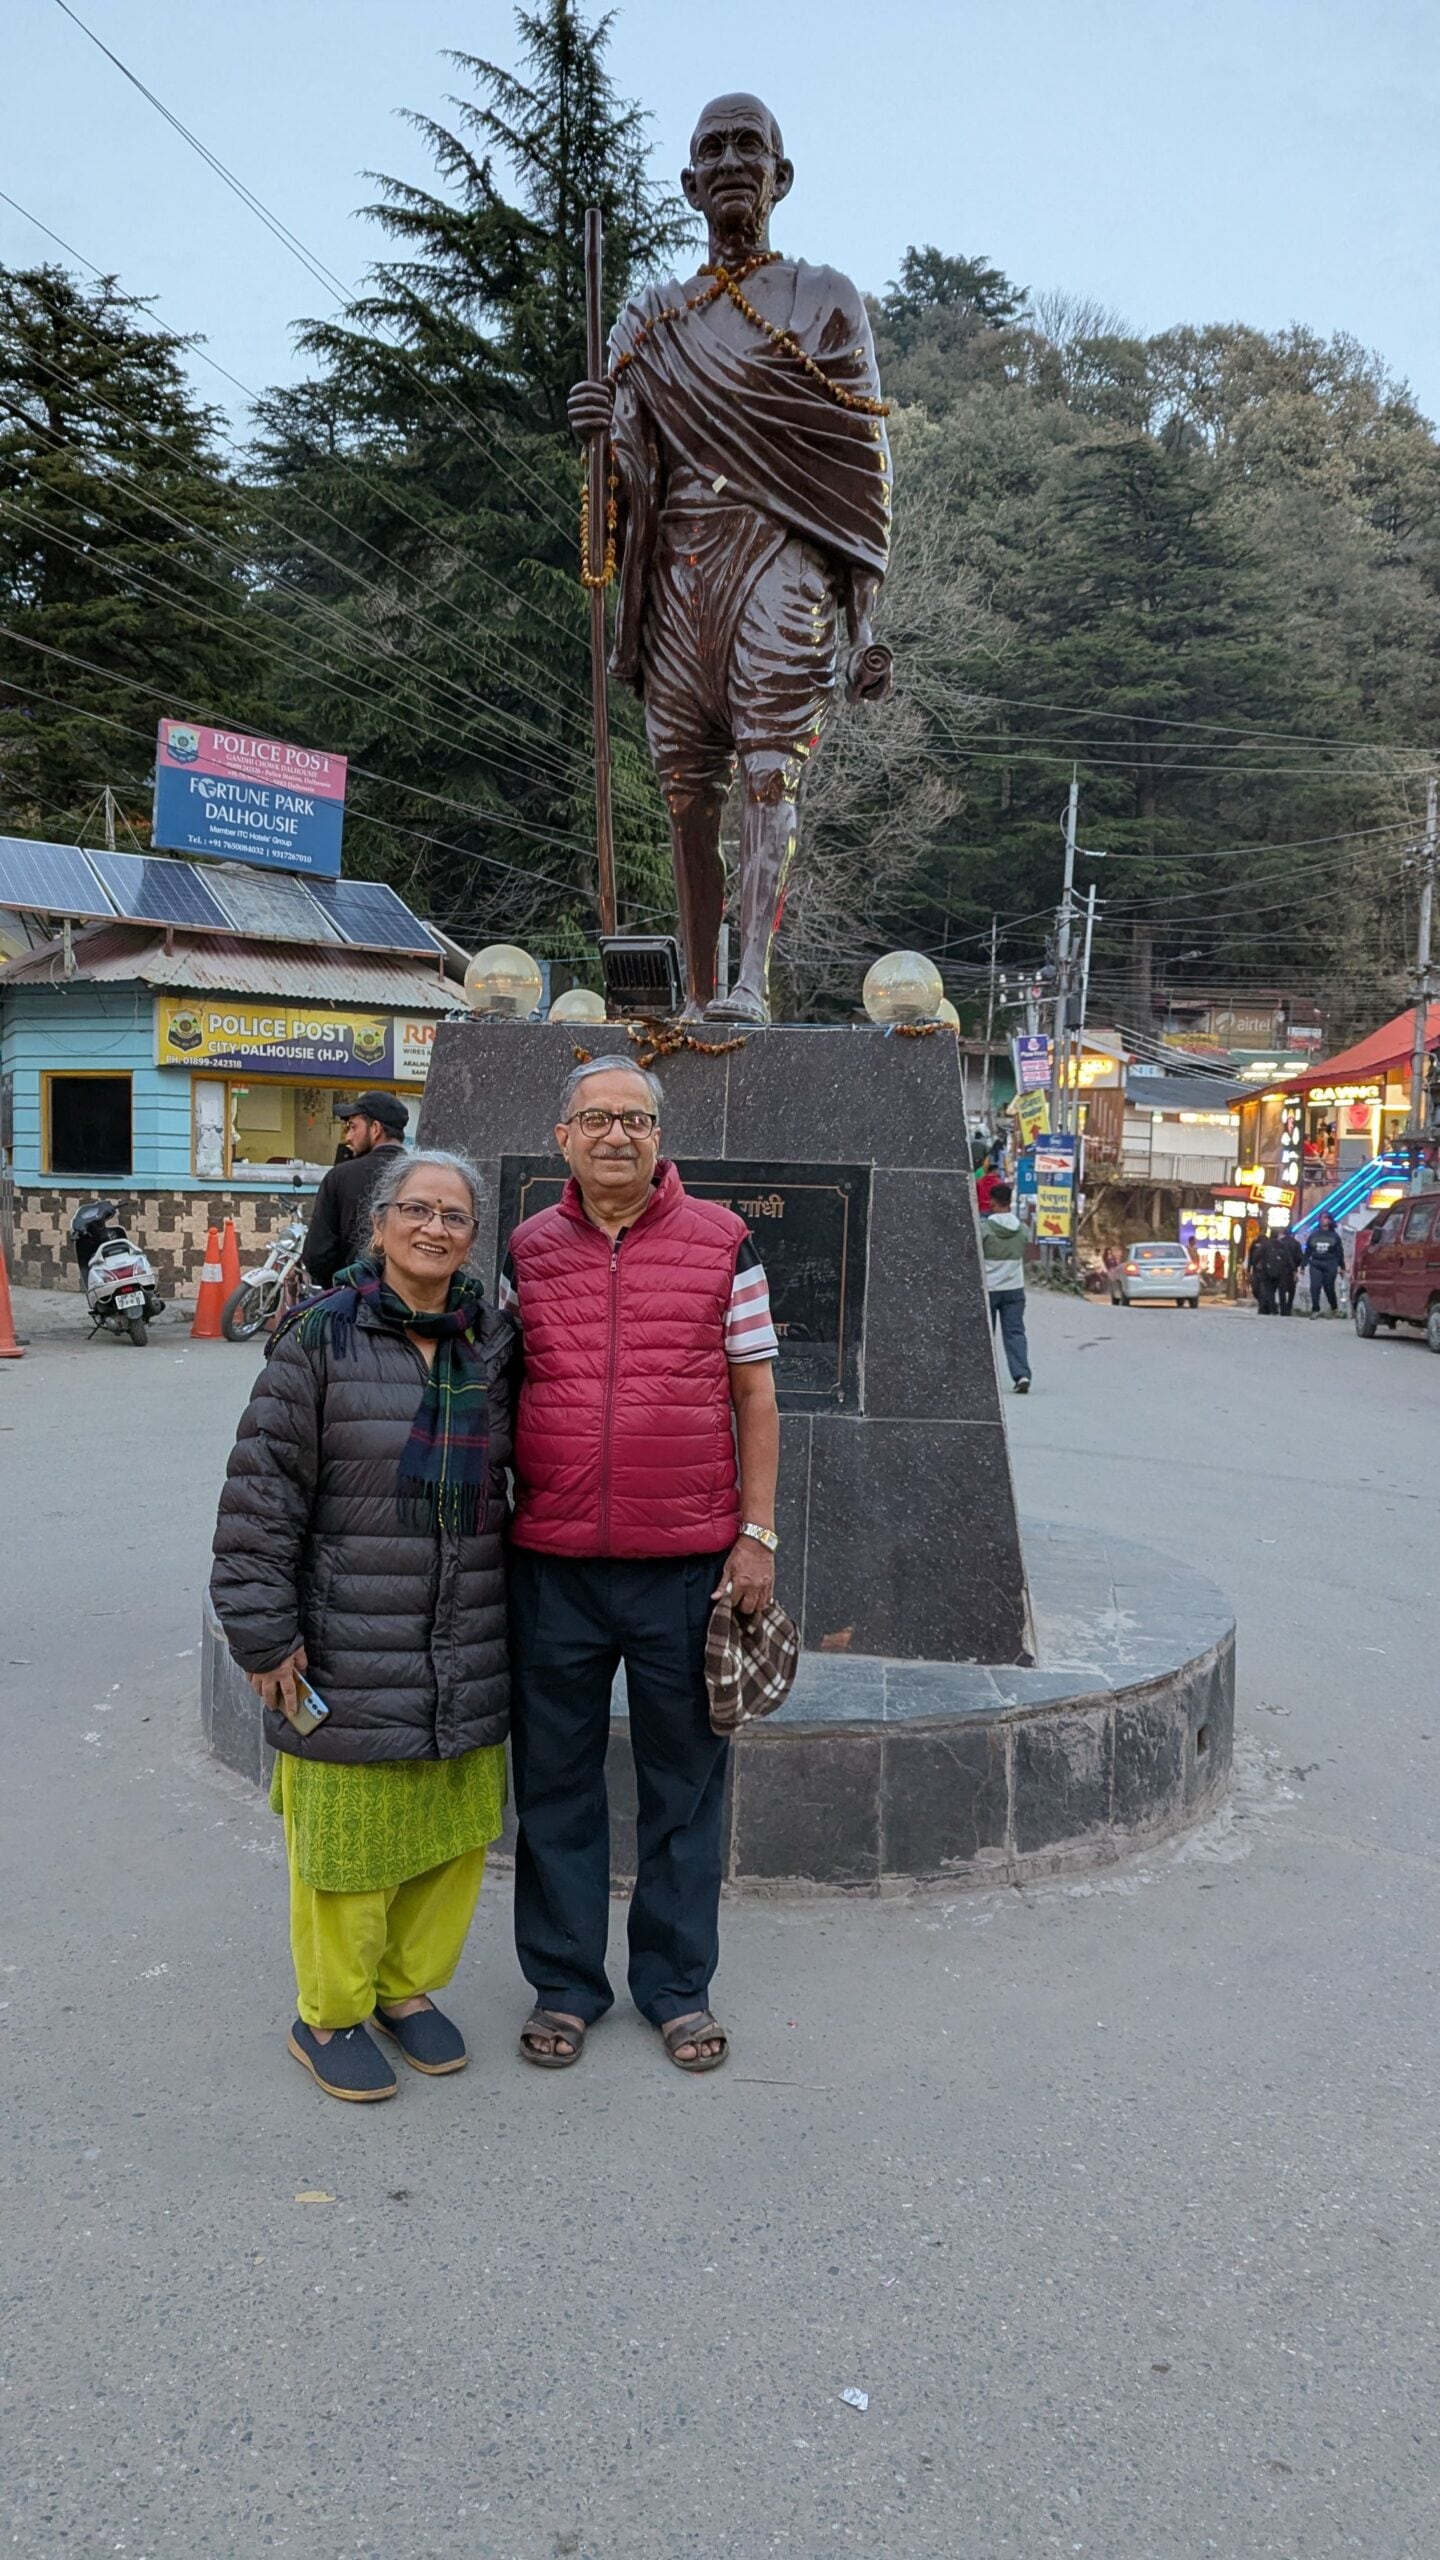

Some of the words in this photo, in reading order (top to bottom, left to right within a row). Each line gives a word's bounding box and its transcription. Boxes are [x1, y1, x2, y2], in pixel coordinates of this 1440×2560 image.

[212, 733, 281, 763] POLICE
[285, 749, 330, 773] POST
[226, 753, 254, 765] GANDHI
[254, 759, 280, 771] CHOWK
[280, 765, 318, 778] DALHOUSIE
[190, 777, 270, 808] FORTUNE
[275, 794, 315, 816] PARK
[205, 802, 299, 835] DALHOUSIE
[188, 834, 202, 844] Tel.
[209, 824, 236, 837] Member
[237, 829, 249, 839] ITC
[272, 836, 292, 847] Group
[208, 1013, 287, 1038] POLICE
[292, 1021, 348, 1043] POST
[1236, 1016, 1271, 1033] airtel
[208, 1041, 237, 1055] CITY
[240, 1043, 315, 1060] DALHOUSIE
[317, 1047, 349, 1063] (H.P)
[403, 1048, 426, 1056] WIRES
[737, 1193, 785, 1218] गांधी
